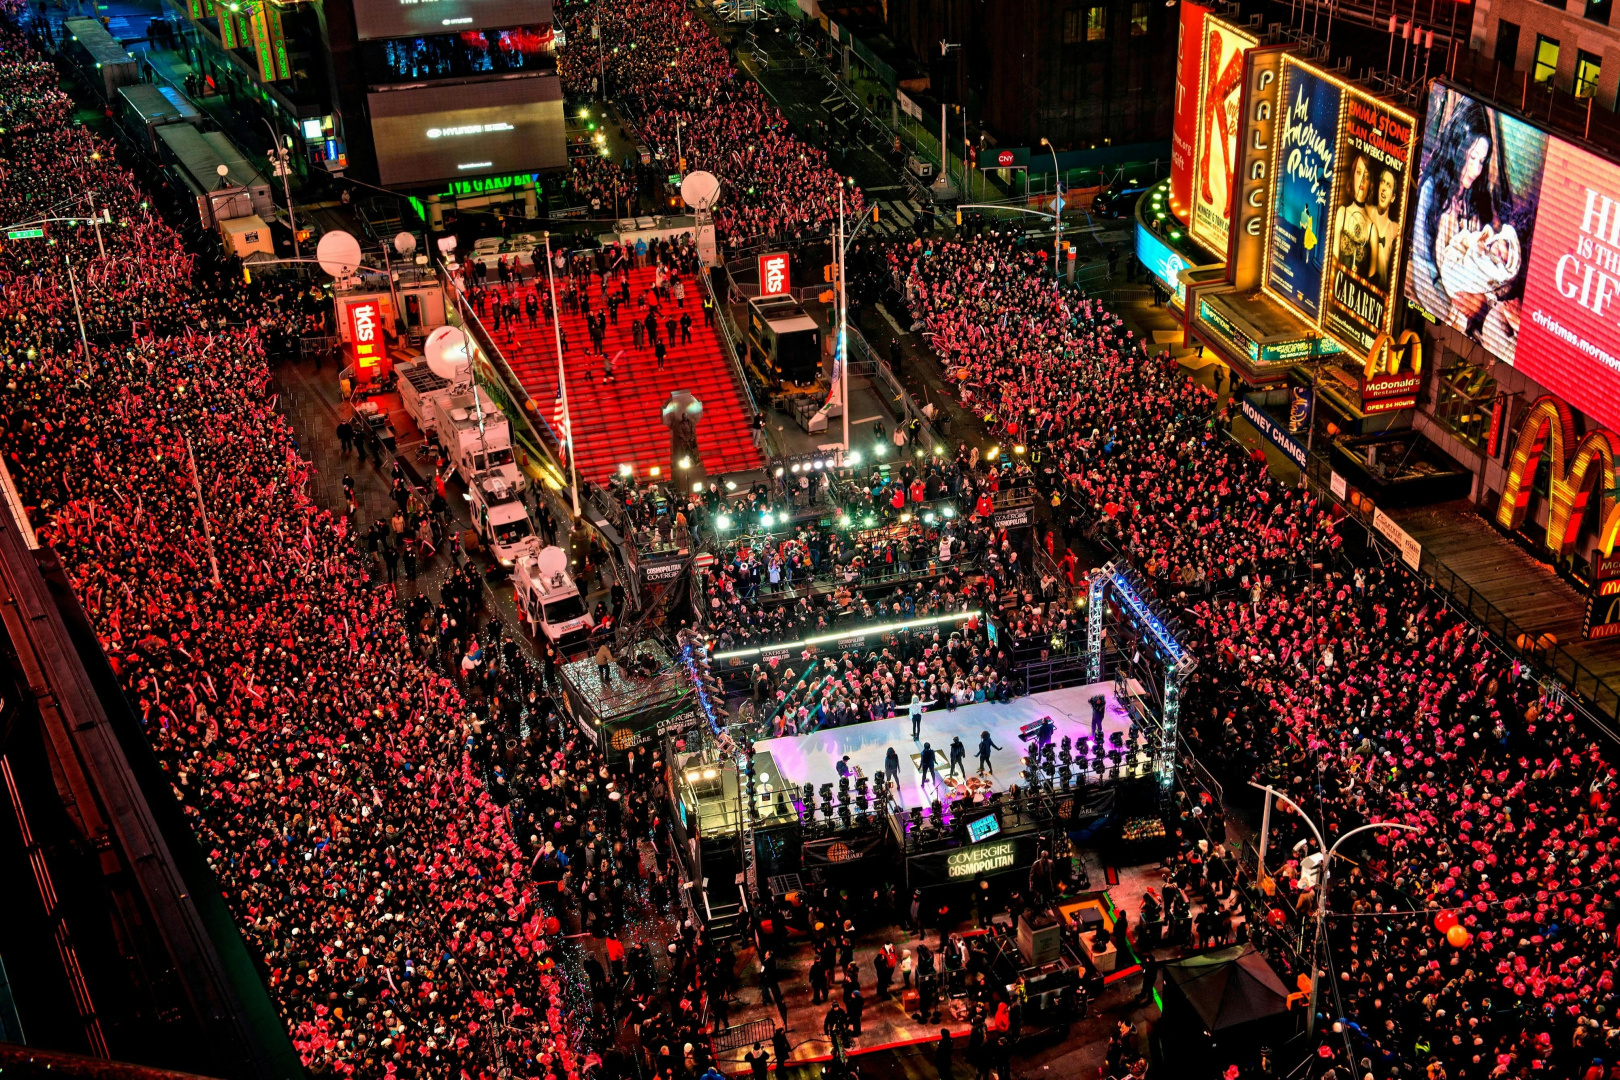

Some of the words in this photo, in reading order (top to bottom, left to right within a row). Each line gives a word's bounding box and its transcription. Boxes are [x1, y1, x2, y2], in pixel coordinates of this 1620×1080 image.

[222, 11, 234, 47] GARDEN
[259, 42, 272, 81] GARDEN
[1292, 83, 1310, 122] An
[442, 125, 481, 136] HYUNDAI
[1348, 99, 1376, 127] EMMA
[1378, 115, 1410, 143] STONE
[998, 155, 1014, 163] CNY
[1246, 69, 1274, 236] PALACE
[1282, 106, 1334, 179] American
[1346, 121, 1367, 141] ALAN
[1368, 132, 1407, 162] CUMMING
[1355, 137, 1362, 150] 12
[1363, 140, 1384, 162] WEEKS
[1385, 154, 1404, 172] ONLY
[473, 174, 531, 192] GARDEN
[1286, 148, 1319, 193] Paris
[1576, 234, 1594, 259] IS
[767, 257, 785, 293] tkts
[1334, 270, 1384, 329] CABARET
[355, 305, 376, 342] tkts
[1365, 378, 1421, 392] McDonald's
[1373, 387, 1410, 396] Restaurant
[1242, 400, 1272, 433] MONEY
[1272, 428, 1306, 467] CHANGE
[646, 563, 682, 574] COSMOPOLITAN
[647, 571, 679, 581] COVERGIR
[947, 843, 1014, 865] COVERGIRL
[948, 854, 1014, 877] COSMOPOLITAN
